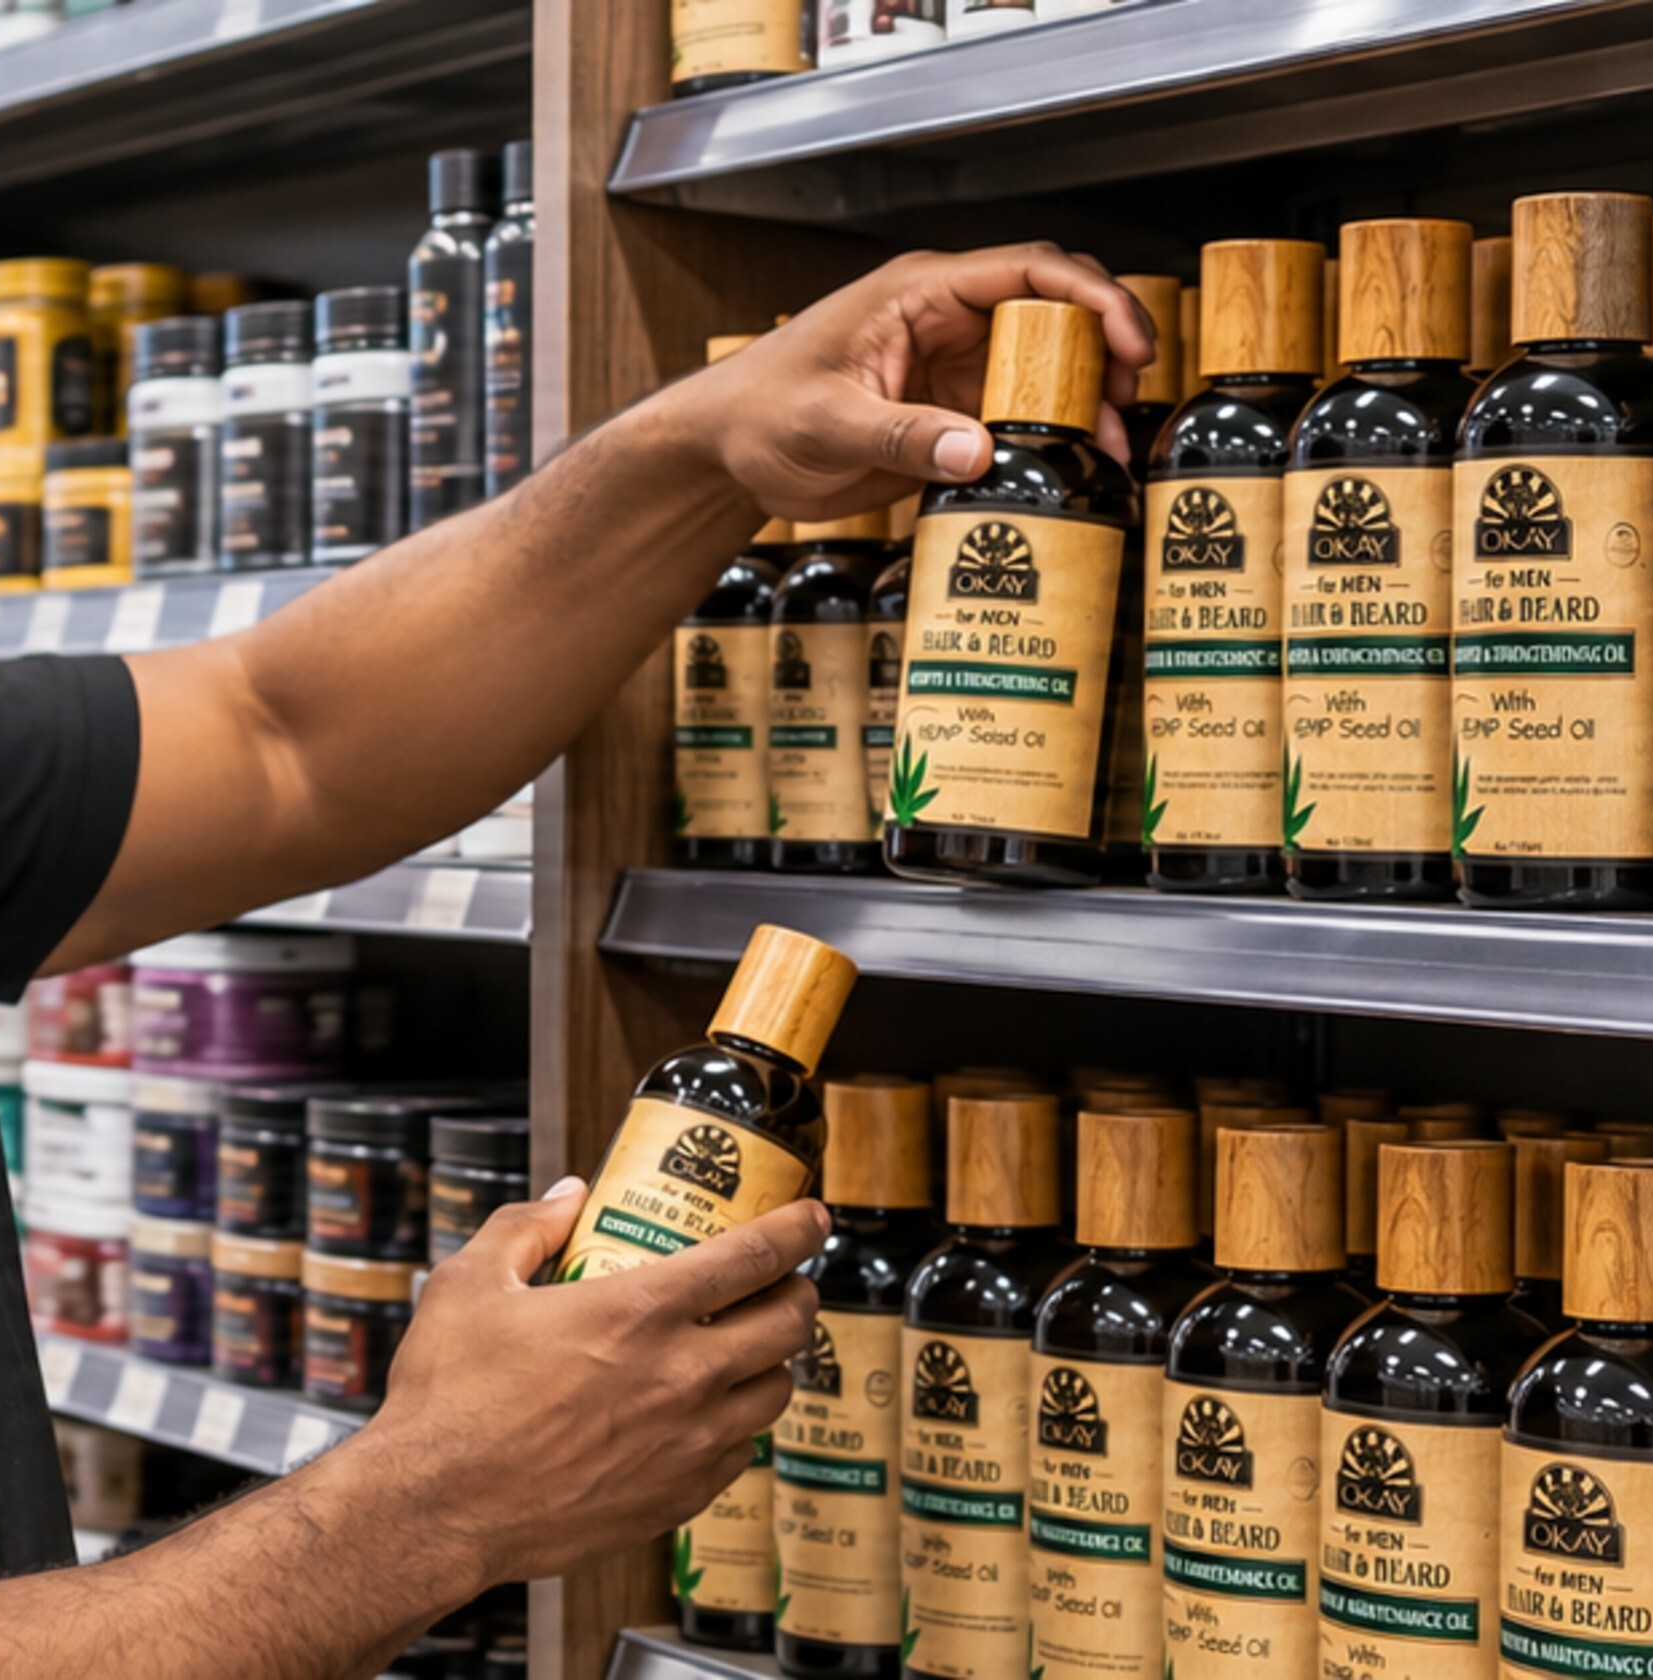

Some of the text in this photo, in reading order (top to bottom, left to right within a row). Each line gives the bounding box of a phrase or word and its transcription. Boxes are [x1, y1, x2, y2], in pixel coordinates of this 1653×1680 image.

[1314, 535, 1389, 561] OKAY
[1480, 526, 1560, 552] OKAY
[1166, 543, 1234, 566] OKAY
[956, 574, 1028, 596] OKAY
[1509, 570, 1551, 588] MEN
[1199, 605, 1267, 630] BEARD
[1350, 602, 1428, 626] BEARD
[1519, 596, 1601, 623] BEARD
[1324, 690, 1366, 712] With
[1490, 689, 1537, 712] With
[1187, 717, 1237, 738] Seed
[1339, 713, 1391, 739] Seed
[1508, 714, 1563, 741] Seed
[1341, 1482, 1412, 1513] OKAY
[1210, 1518, 1281, 1551] BEARD
[1530, 1525, 1612, 1556] OKAY
[1560, 1570, 1604, 1594] MEN
[1571, 1598, 1652, 1633] BEARD
